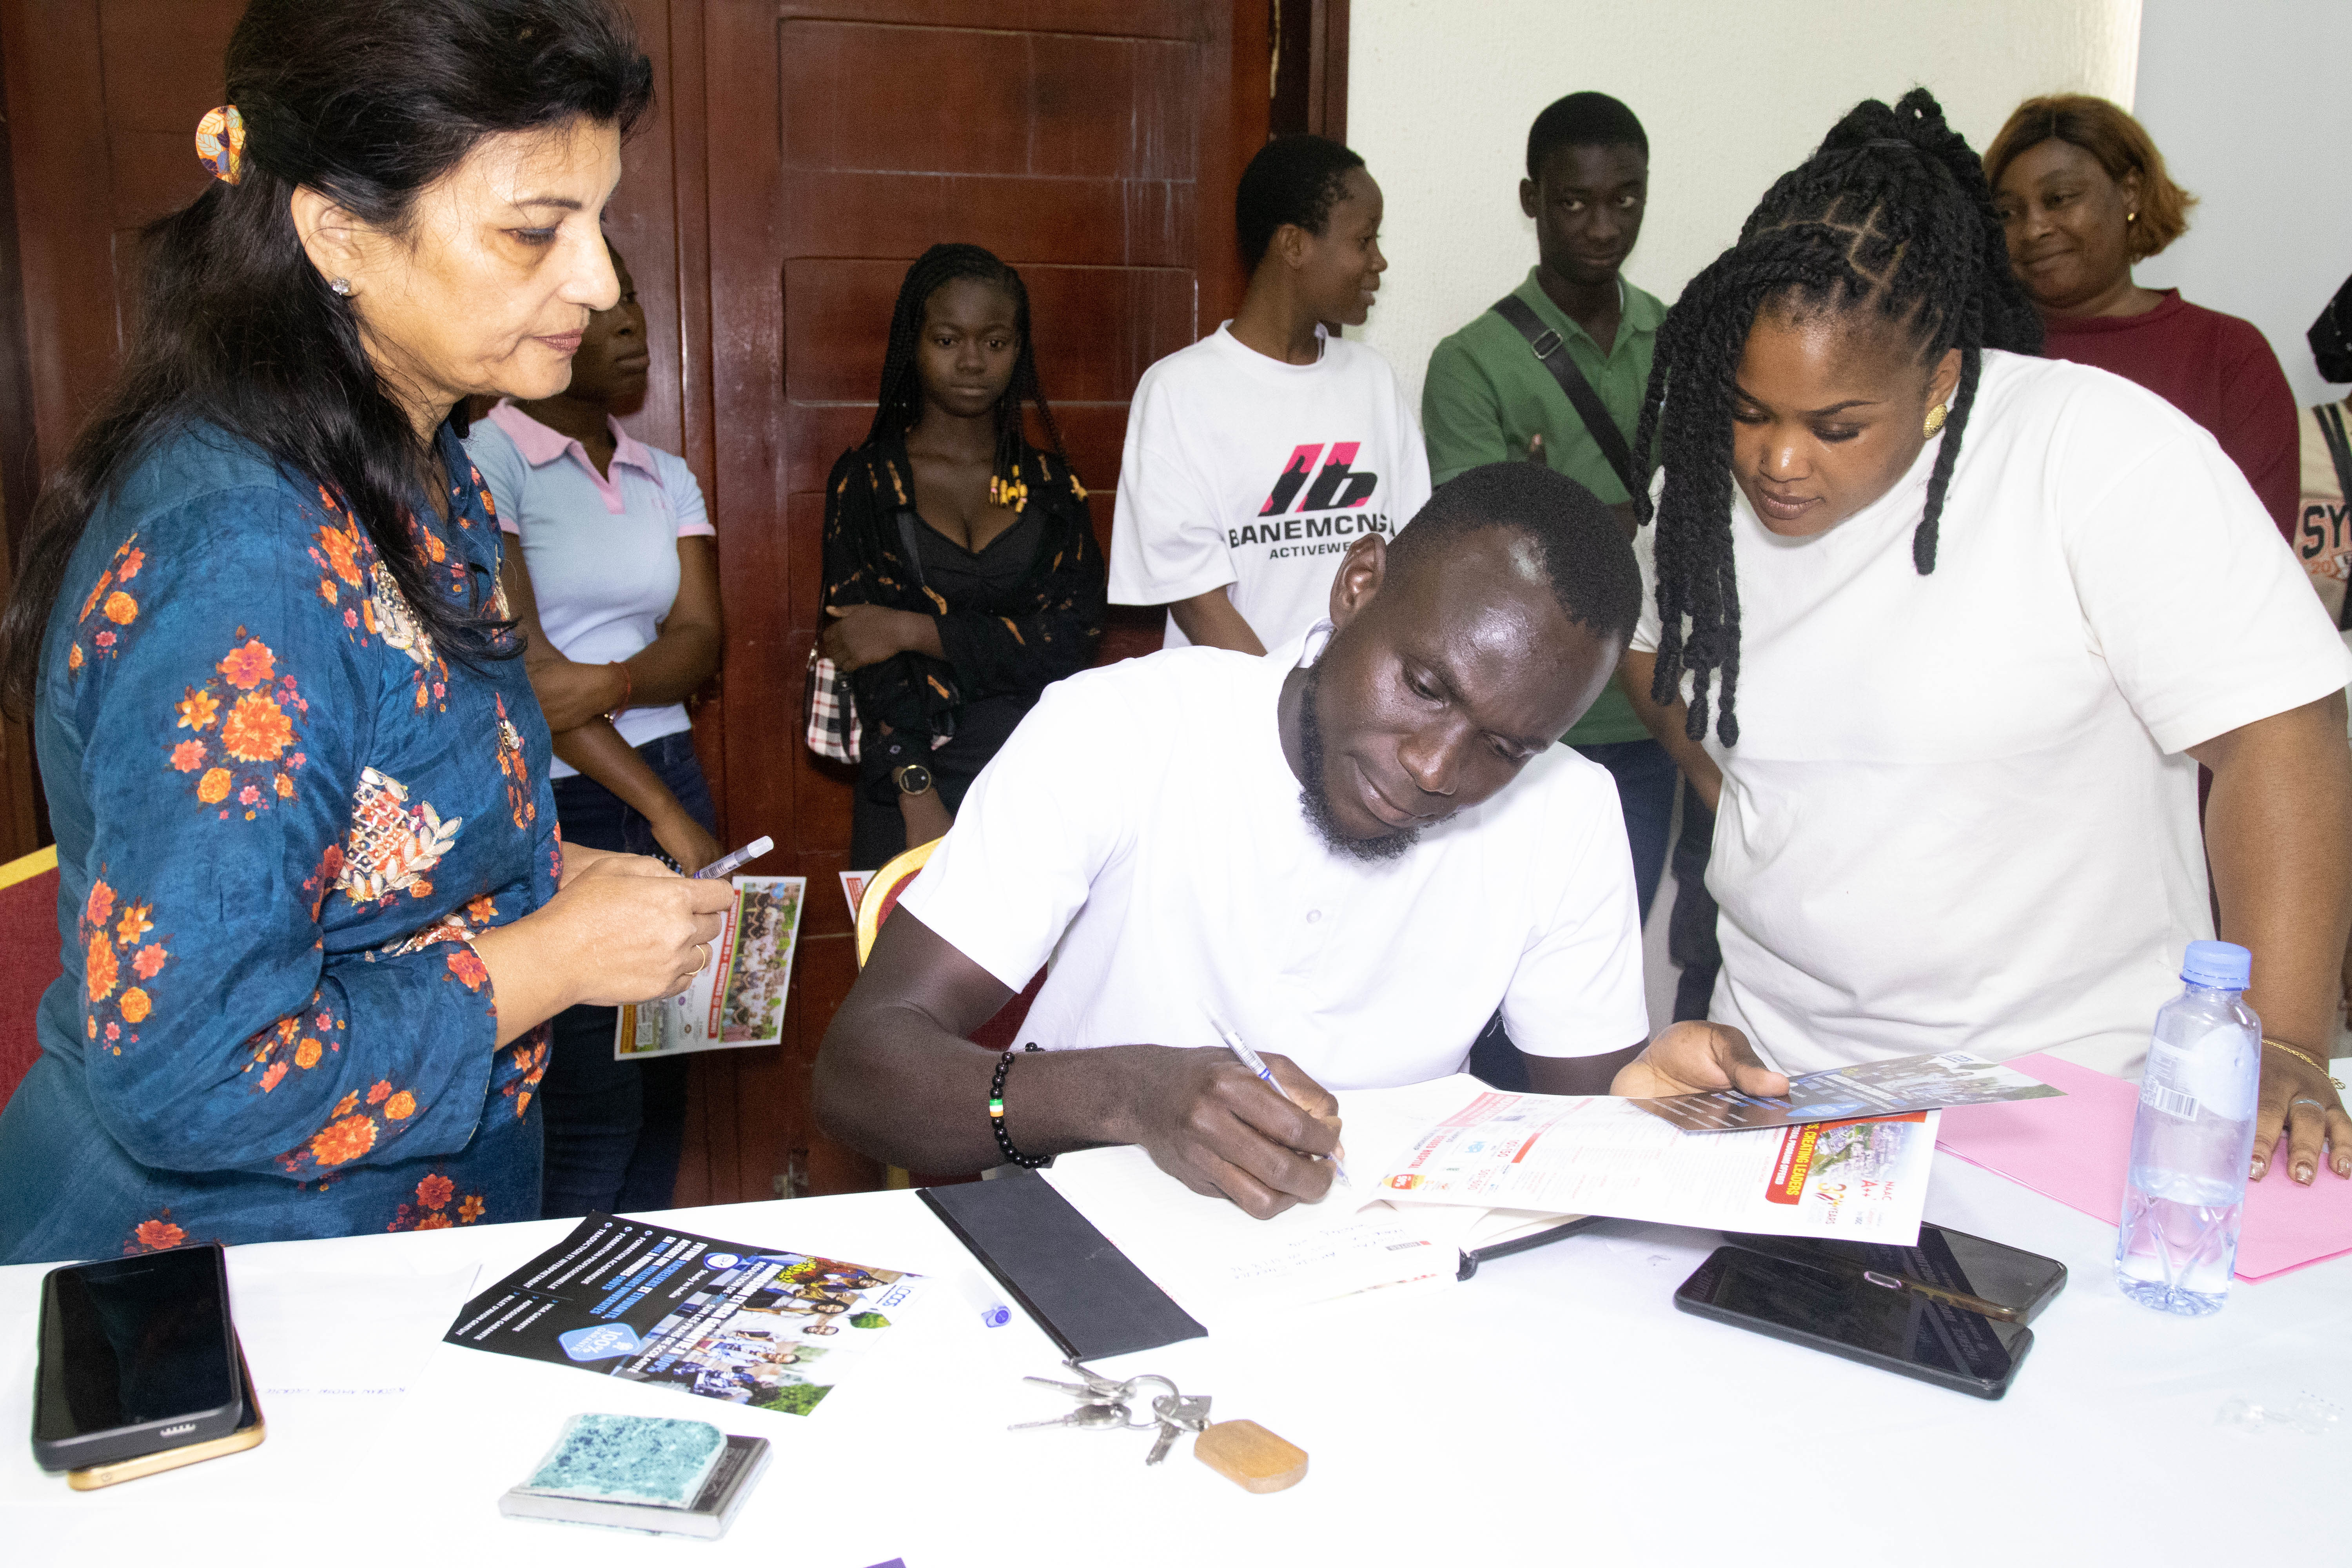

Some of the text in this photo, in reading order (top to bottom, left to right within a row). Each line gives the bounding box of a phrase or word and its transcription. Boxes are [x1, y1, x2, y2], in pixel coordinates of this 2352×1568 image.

[2302, 505, 2352, 559] SY
[1269, 541, 1352, 559] ACTIVEWE
[1497, 1140, 1520, 1157] 101-150
[1781, 1140, 1797, 1166] PROGRAMS
[1796, 1131, 1817, 1163] CREATING
[1775, 1164, 1789, 1185] OFFERED
[1786, 1164, 1807, 1196] LEADERS
[1882, 1180, 1895, 1201] NAAC
[1825, 1206, 1838, 1225] YEARS
[569, 1228, 607, 1255] TRADUCTION
[649, 1242, 670, 1254] INDE
[677, 1242, 709, 1261] FUTURS
[545, 1232, 627, 1290] FORMATION PROFESSIONNELLE
[579, 1236, 647, 1285] FORMATION ACADÉMIQUE
[618, 1255, 655, 1277] MOINDRES
[651, 1256, 671, 1267] AUX
[623, 1265, 661, 1288] MEILLEURS
[642, 1259, 688, 1288] BACHELIERS
[685, 1269, 710, 1282] Study
[730, 1261, 768, 1287] RÉDUCTION
[736, 1263, 785, 1297] ADMISSION
[587, 1286, 633, 1315] UNIVERSITÉS
[635, 1285, 654, 1294] ET
[666, 1286, 689, 1299] India
[721, 1286, 737, 1294] DE
[727, 1294, 748, 1304] ET
[452, 1295, 516, 1336] BILLET D'AVION GRATUIT
[510, 1303, 555, 1332] VISA GARANTIE
[686, 1314, 704, 1324] LES
[698, 1303, 717, 1314] SUR
[710, 1302, 739, 1319] VISA
[472, 1299, 534, 1341] ADMISSION GARANTIE
[669, 1322, 694, 1338] FRAIS
[568, 1327, 607, 1352] GARANTIE
[580, 1330, 624, 1355] 100%
[660, 1336, 677, 1345] DE
[673, 1317, 723, 1350] GARANTIE
[625, 1344, 668, 1374] SCOLARITÉ
[644, 1353, 680, 1374] 100%
